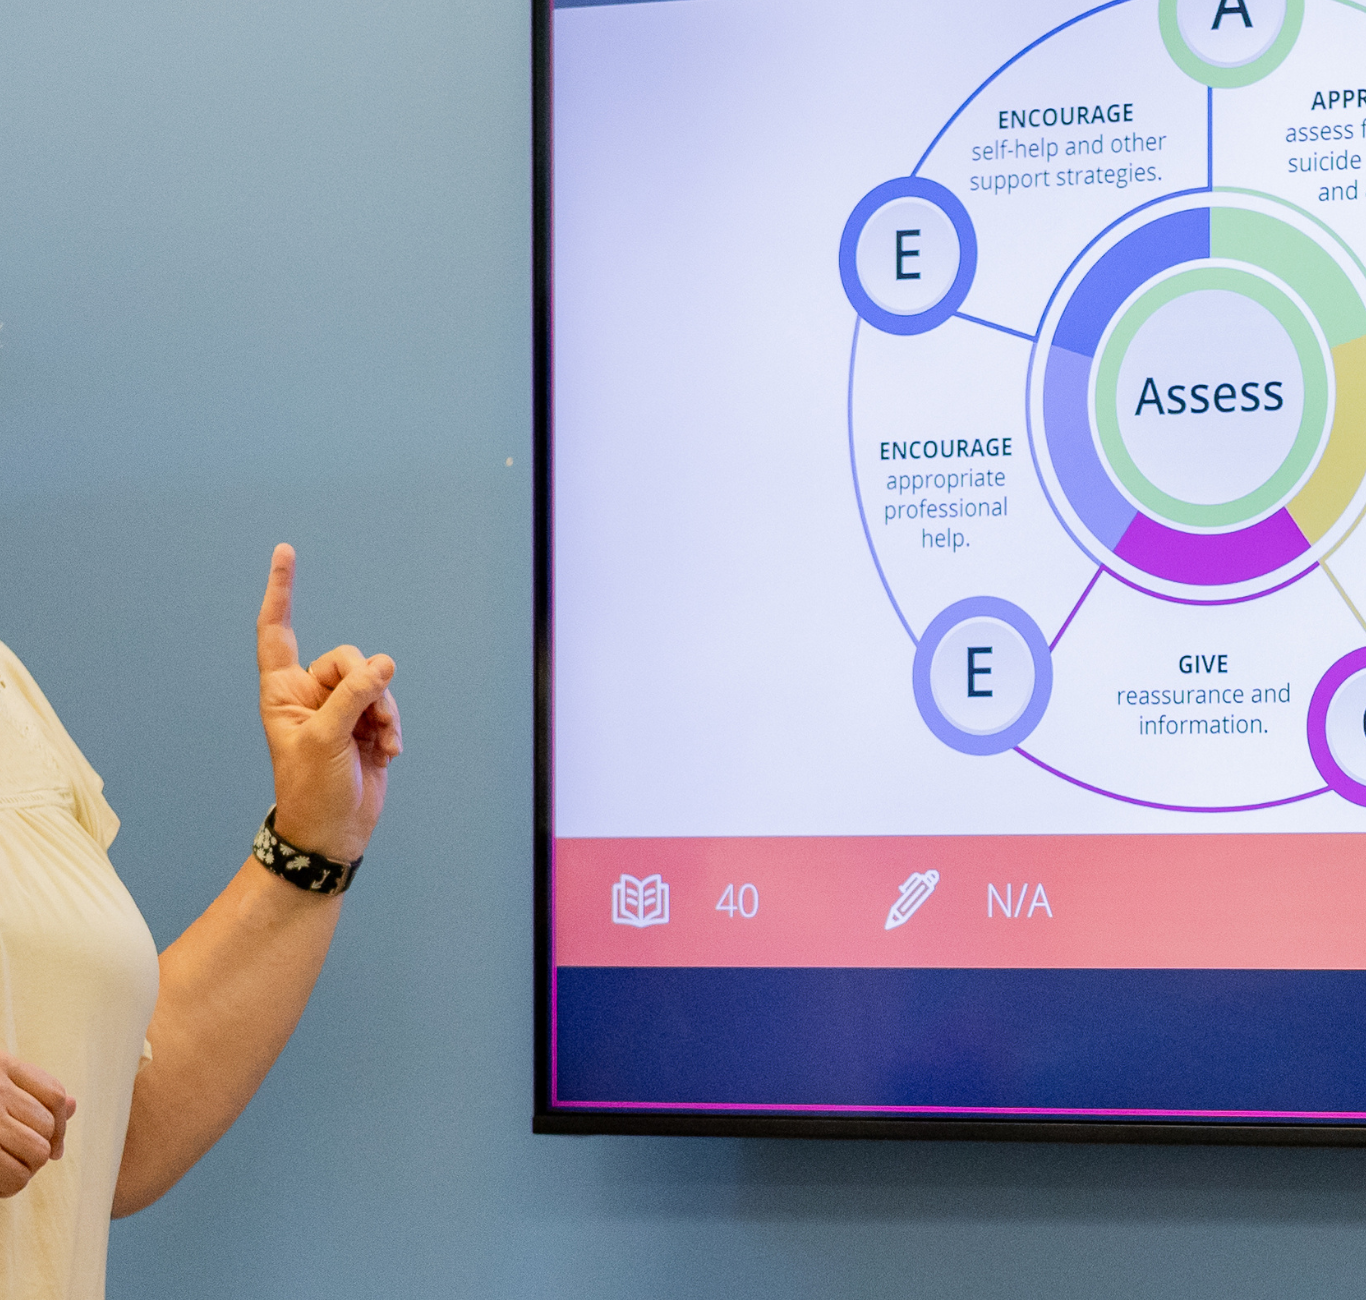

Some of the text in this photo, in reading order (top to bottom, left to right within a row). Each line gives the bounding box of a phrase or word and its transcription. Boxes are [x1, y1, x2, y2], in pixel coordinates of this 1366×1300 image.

[1211, 0, 1253, 30] A
[999, 103, 1133, 130] ENCOURAGE
[1285, 124, 1354, 143] assess
[972, 132, 1167, 163] self-help and other
[1288, 149, 1362, 173] suicide
[970, 166, 1163, 195] support strategies.
[1318, 179, 1358, 202] and
[895, 229, 921, 281] E
[1134, 377, 1284, 416] Assess
[880, 437, 1012, 461] ENCOURAGE
[886, 470, 1006, 495] appropriate
[884, 496, 1007, 526] professional
[922, 527, 970, 553] help.
[967, 646, 993, 698] E
[1179, 654, 1228, 674] GIVE
[1117, 682, 1290, 706] reassurance and
[1140, 714, 1268, 735] information.
[715, 883, 759, 918] 40
[987, 883, 1053, 918] N/A
